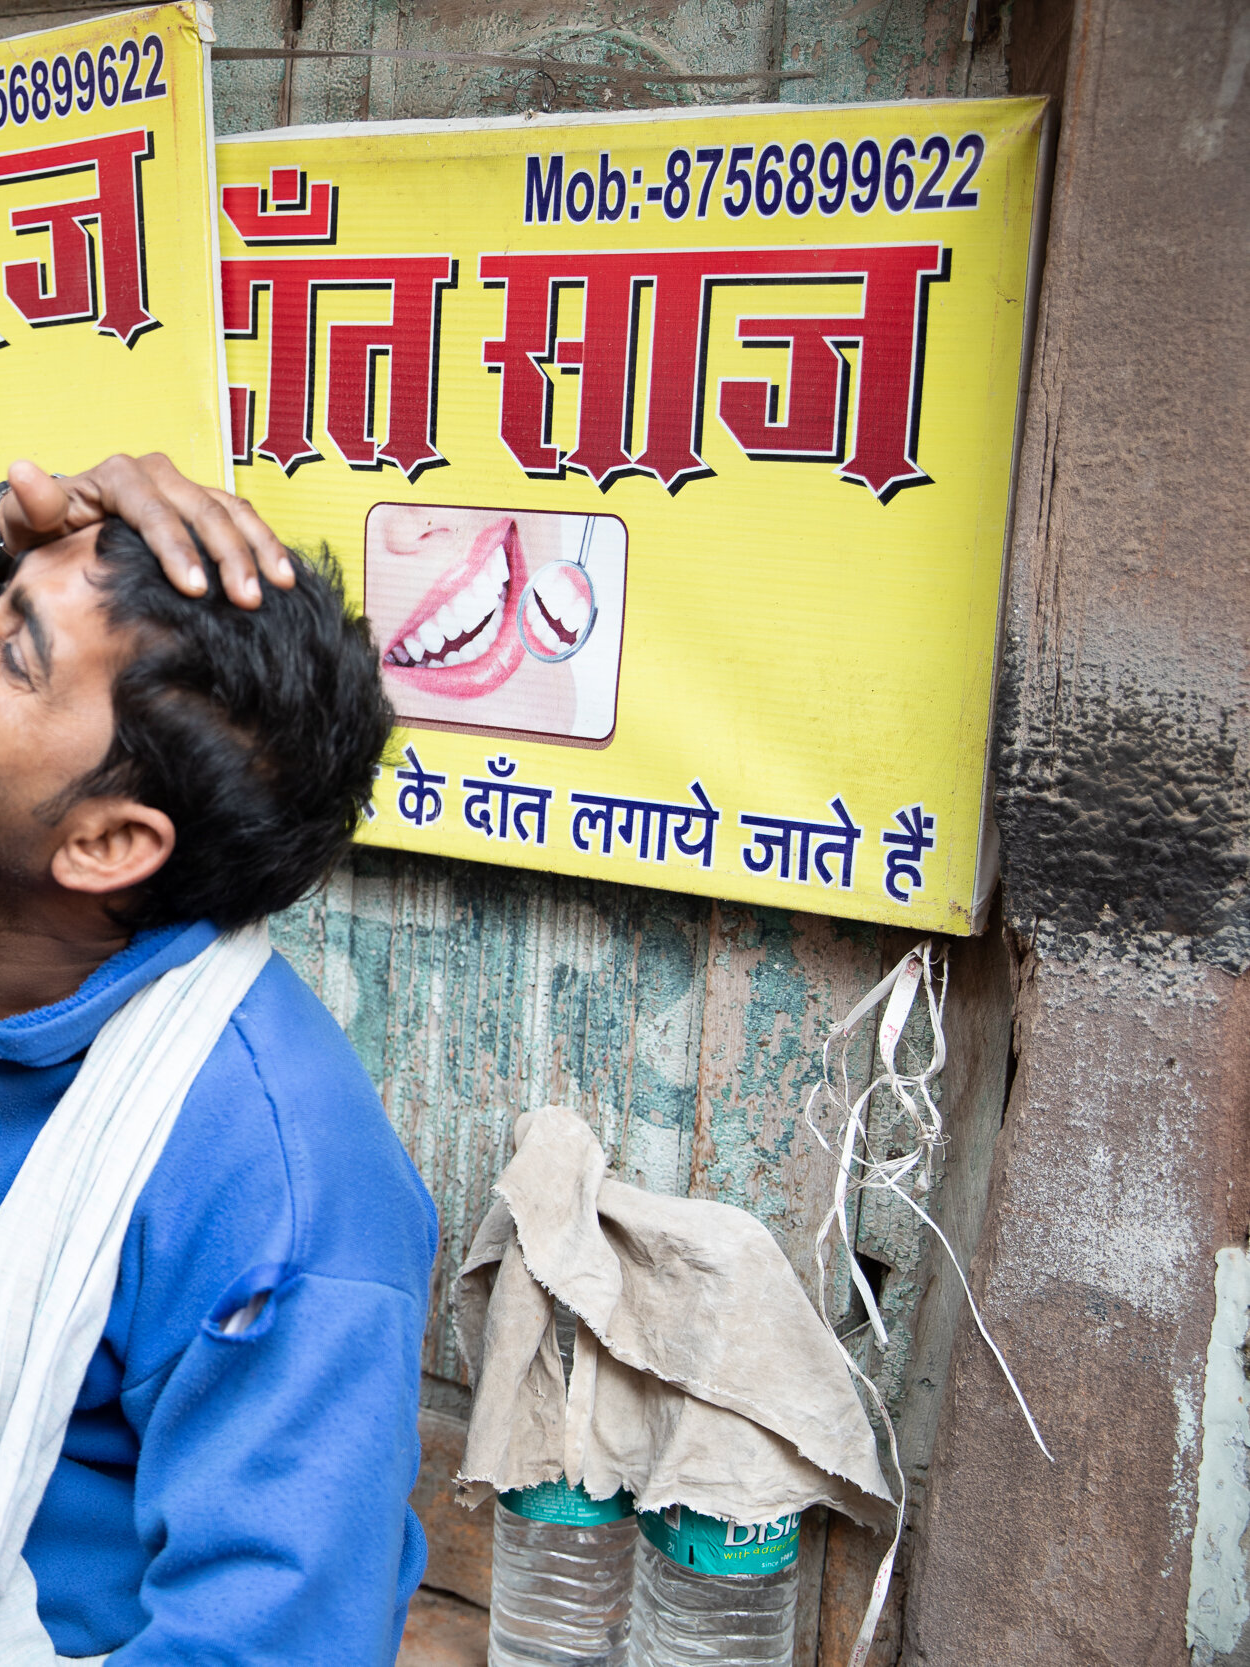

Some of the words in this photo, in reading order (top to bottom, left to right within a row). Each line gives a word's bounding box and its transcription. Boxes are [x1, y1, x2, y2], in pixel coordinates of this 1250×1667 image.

[523, 133, 985, 224] Mob:-8756899622
[479, 243, 951, 505] साज
[396, 743, 447, 827] के
[463, 755, 553, 845] दाँत
[570, 779, 719, 868] लगाये
[740, 795, 861, 888] जाते
[883, 801, 935, 904] हैं
